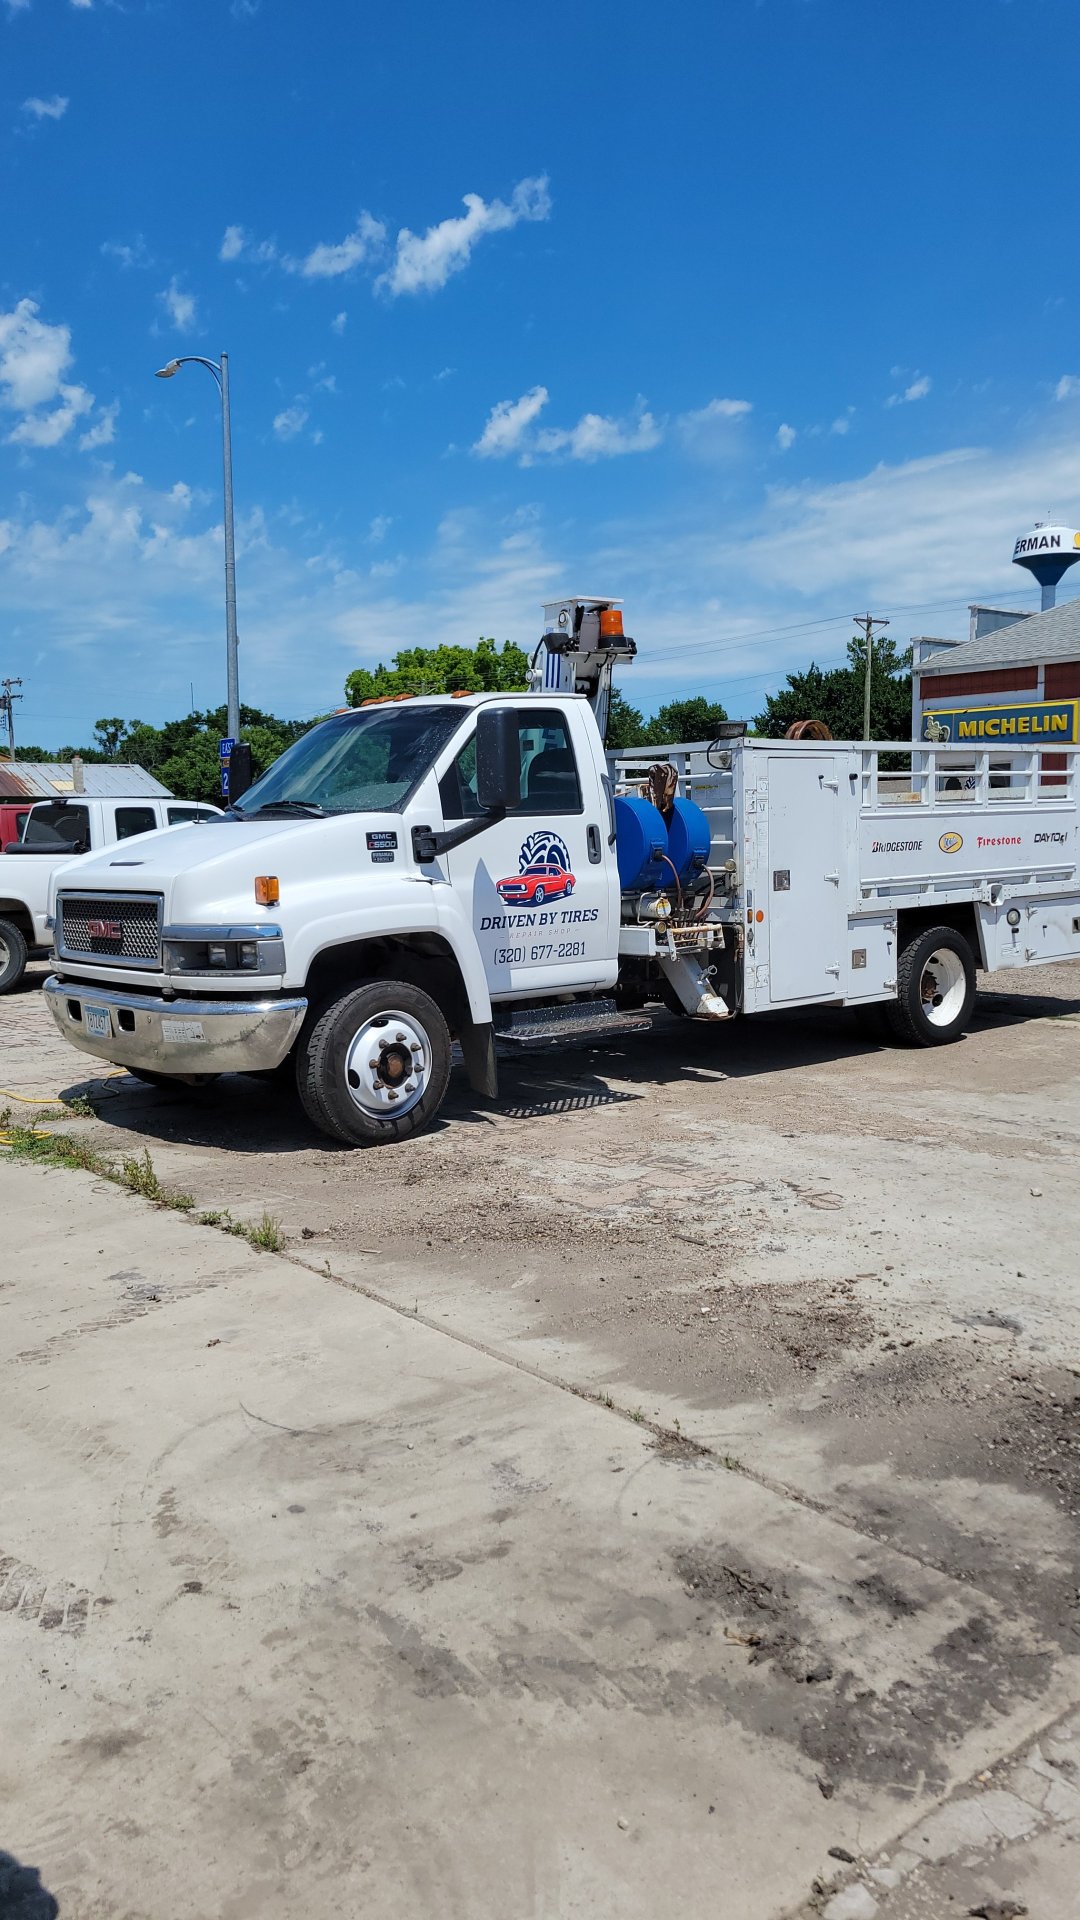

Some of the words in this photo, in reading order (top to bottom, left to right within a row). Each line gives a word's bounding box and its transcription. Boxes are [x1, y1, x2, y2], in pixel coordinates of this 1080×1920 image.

[1014, 534, 1061, 555] ERMAN
[958, 713, 1068, 738] MICHELIN
[223, 772, 229, 790] 2
[368, 840, 397, 849] C5500
[872, 840, 923, 853] BRIDGESTONE
[977, 836, 1022, 849] Firestone
[480, 913, 536, 931] DRIVEN
[539, 911, 558, 926] BY
[561, 908, 599, 924] TIRES
[88, 920, 121, 938] GMC
[509, 930, 543, 940] REPAIR
[549, 927, 571, 936] SHOP
[493, 945, 526, 965] (320)
[531, 941, 585, 961] 677-2281
